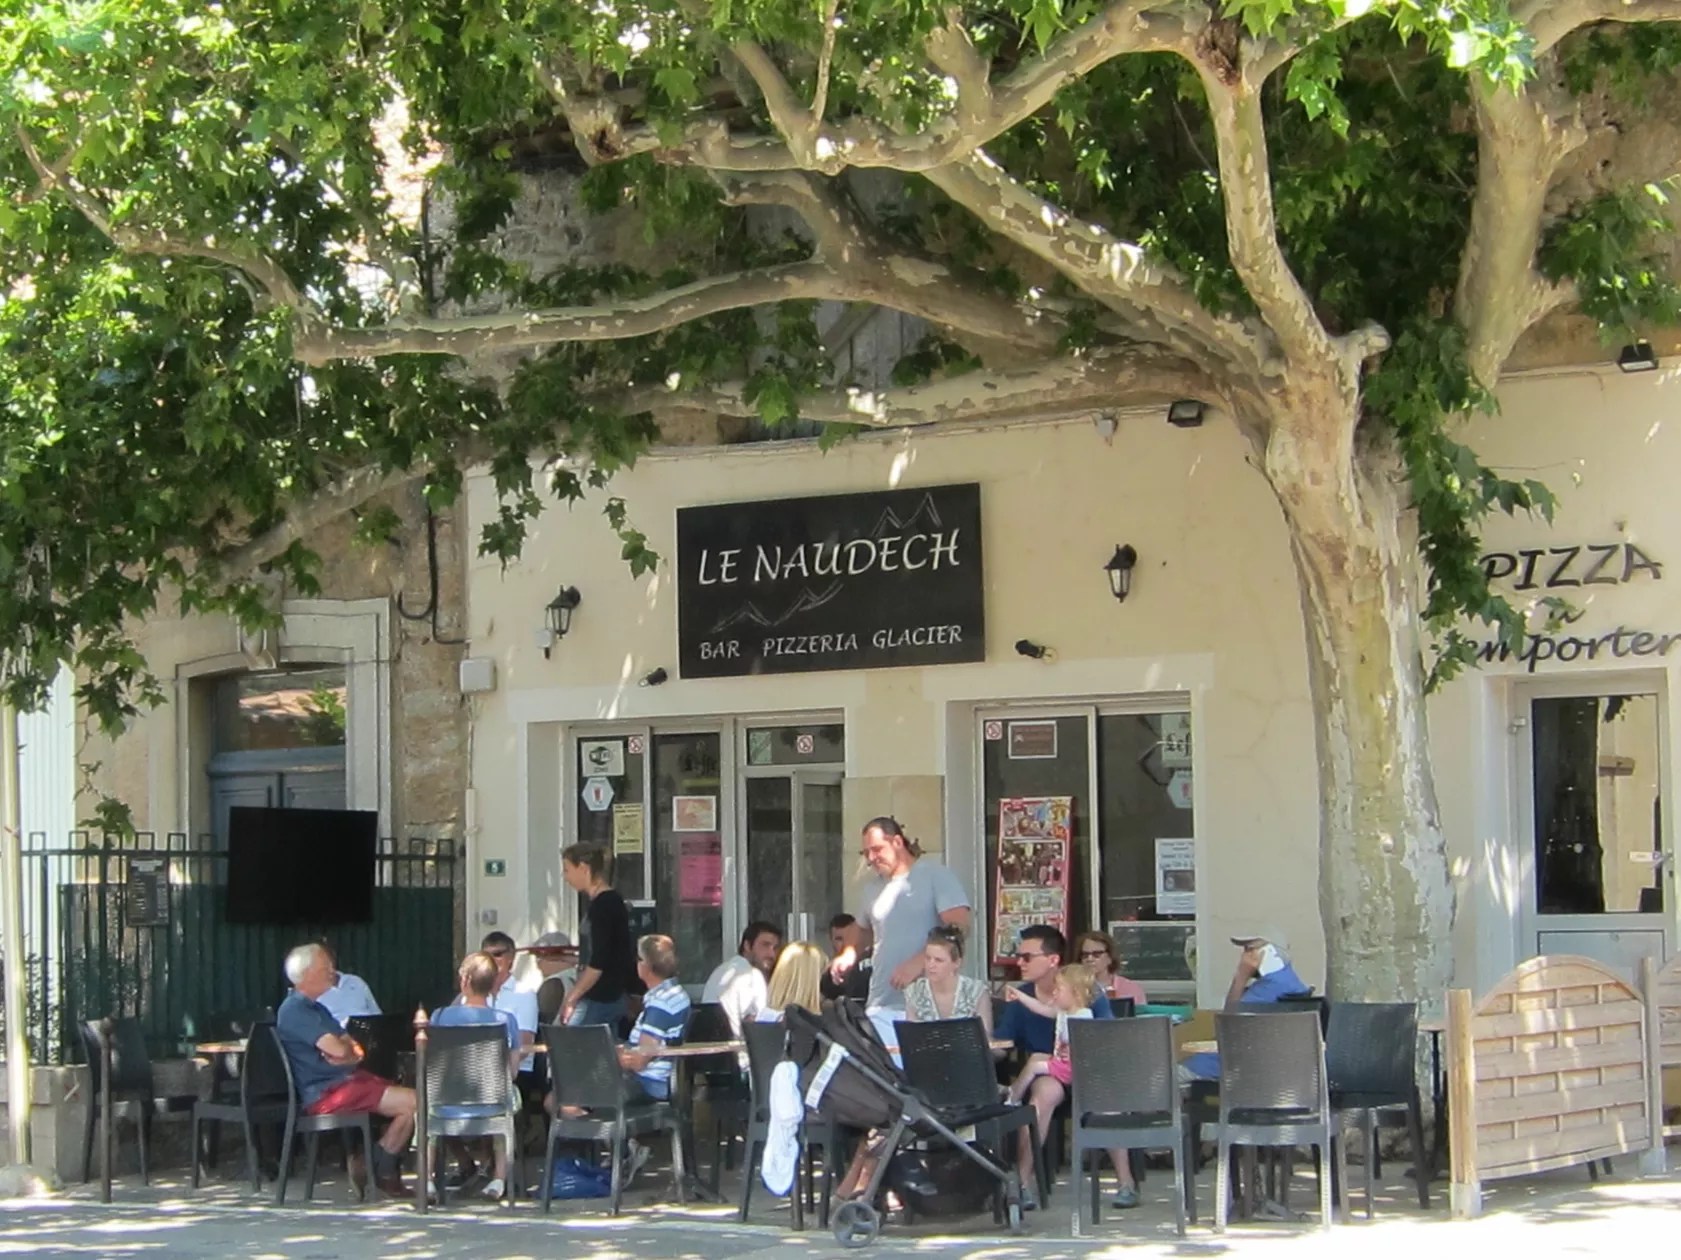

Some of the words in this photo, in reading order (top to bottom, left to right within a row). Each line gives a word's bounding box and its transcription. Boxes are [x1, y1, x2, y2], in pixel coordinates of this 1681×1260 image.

[698, 549, 741, 585] LE
[754, 527, 961, 582] NAUDECH
[1479, 543, 1663, 591] PIZZA
[699, 640, 741, 660] BAR
[763, 633, 858, 657] PIZZERIA
[872, 625, 962, 649] GLACIER
